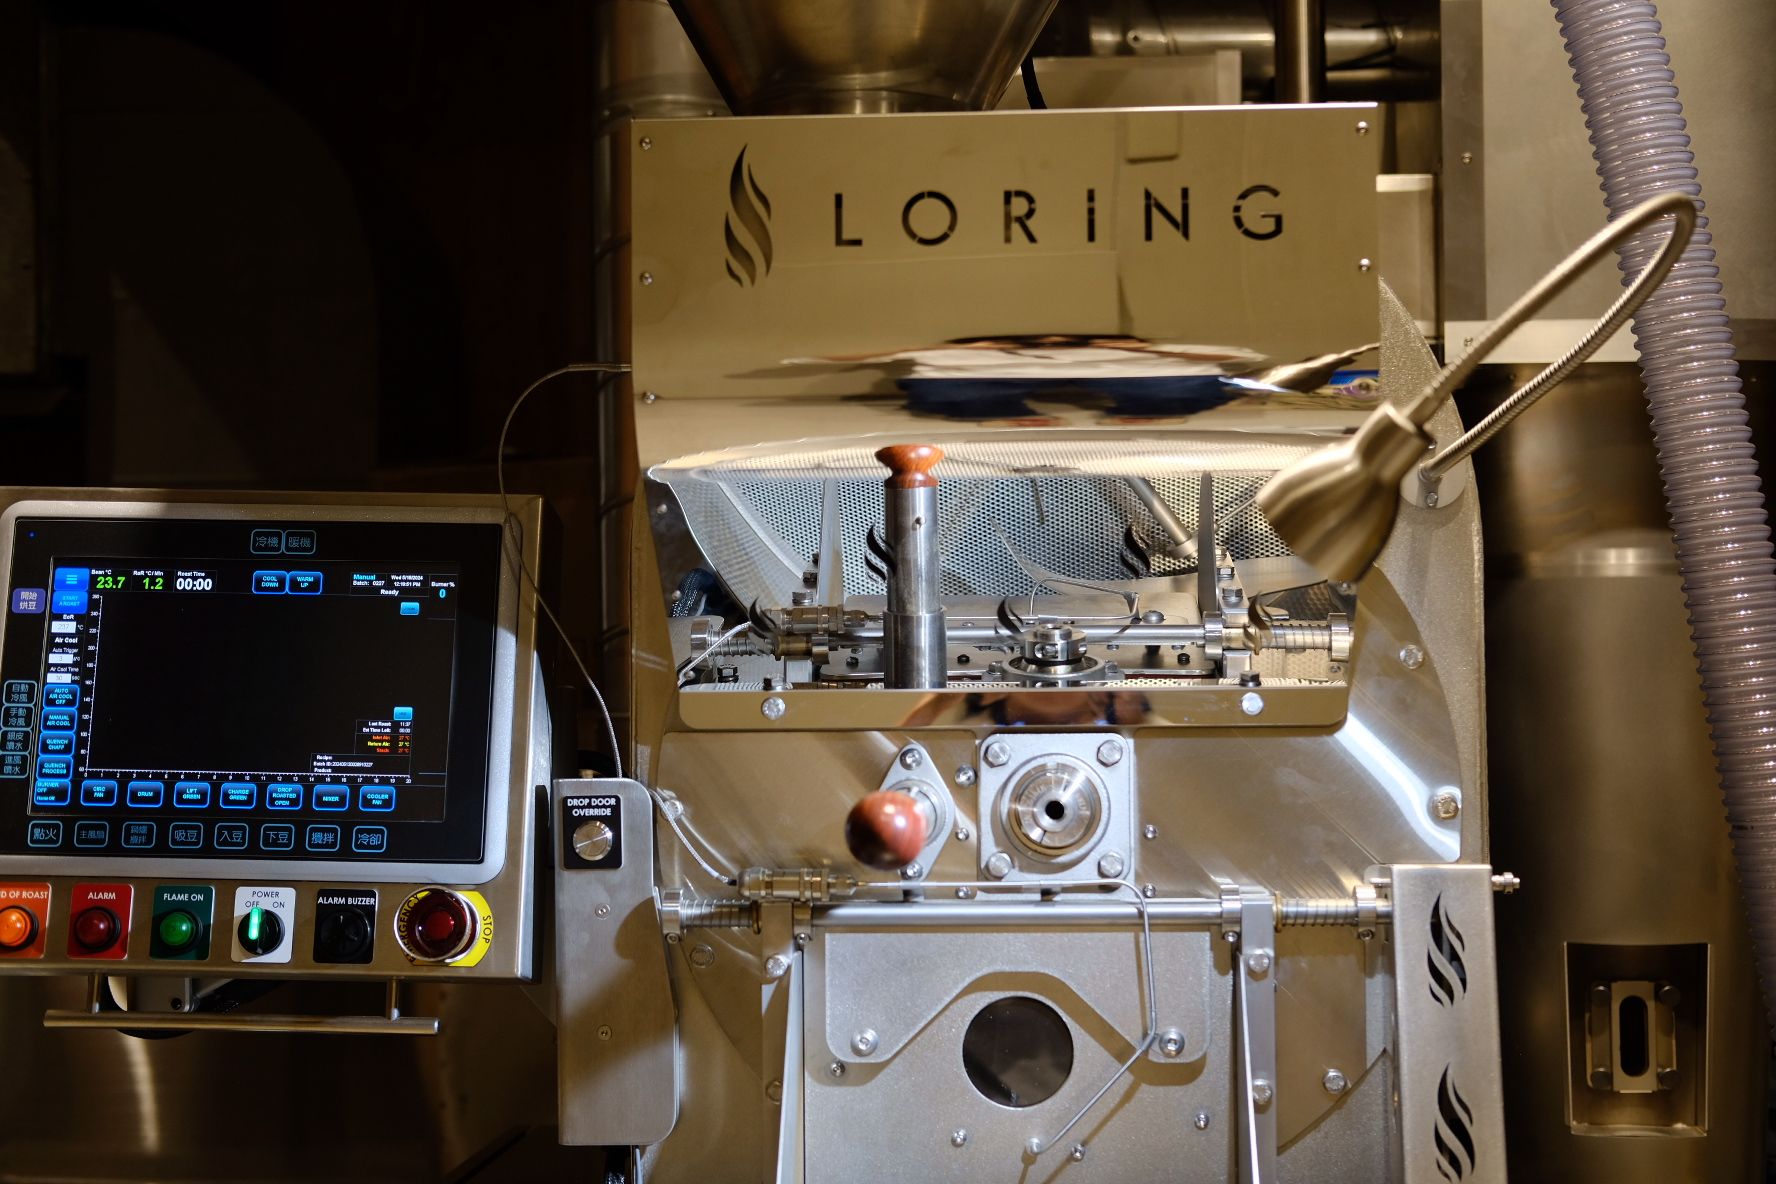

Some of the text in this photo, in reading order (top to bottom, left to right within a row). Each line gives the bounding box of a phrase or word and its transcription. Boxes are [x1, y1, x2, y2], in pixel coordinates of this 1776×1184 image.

[835, 184, 1283, 247] LORING
[255, 536, 279, 548] 冷機
[96, 576, 126, 589] 23.7
[143, 578, 164, 589] 1.2
[176, 578, 213, 591] 00:00
[439, 589, 446, 598] 0
[12, 684, 29, 692] 自動
[10, 708, 27, 717] 手動
[591, 798, 616, 806] DOOR
[572, 808, 612, 816] OVERRIDE
[33, 828, 57, 841] 點火
[174, 830, 198, 842] 吸豆
[219, 830, 243, 843] 入豆
[266, 831, 289, 843] 下豆
[311, 832, 335, 844] 攪拌
[357, 833, 382, 846] 冷卻
[9, 891, 20, 899] OF
[22, 891, 48, 899] ROAST
[88, 892, 116, 900] ALARM
[163, 893, 190, 901] FLAME
[272, 901, 285, 909] ON
[317, 896, 376, 906] ALARM BUZZER
[482, 915, 493, 944] STOP
